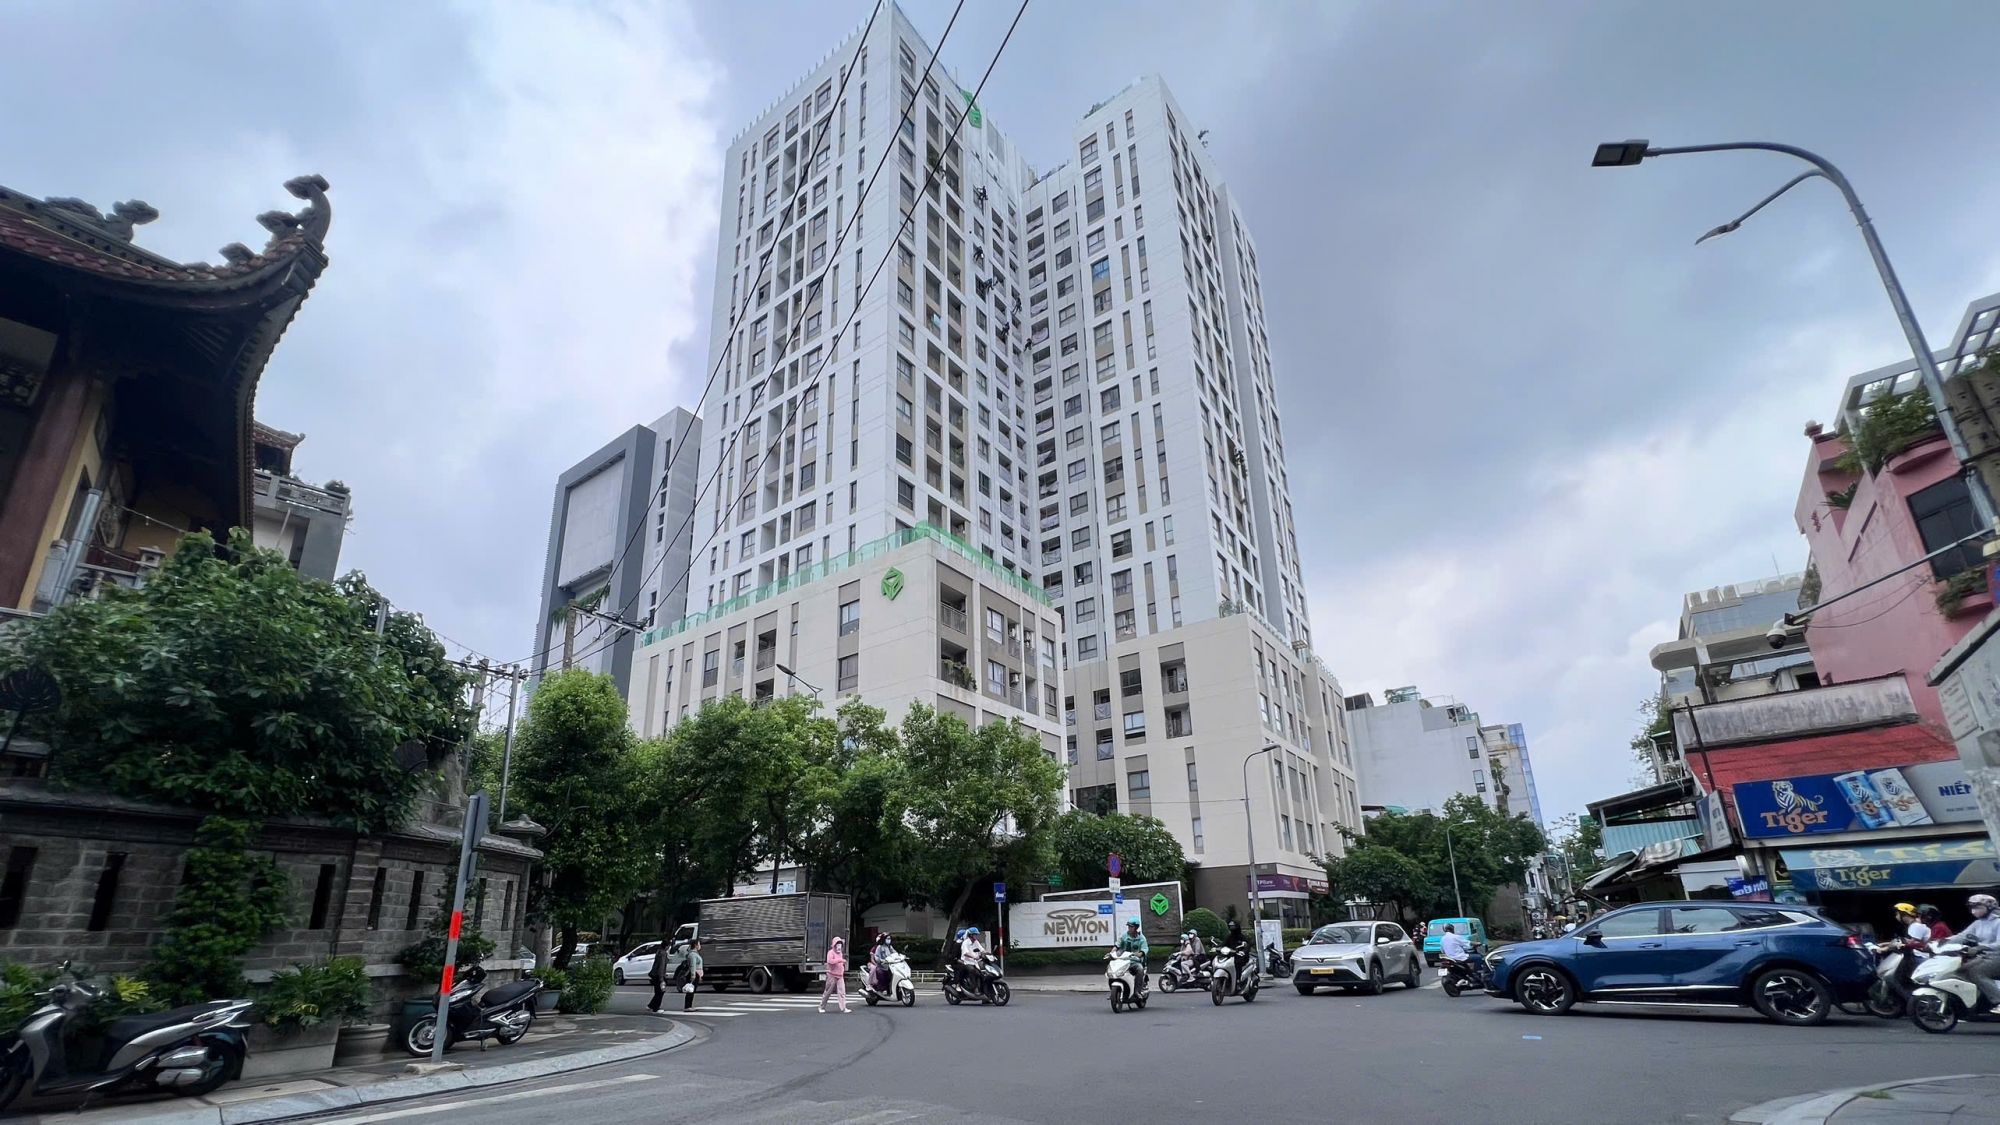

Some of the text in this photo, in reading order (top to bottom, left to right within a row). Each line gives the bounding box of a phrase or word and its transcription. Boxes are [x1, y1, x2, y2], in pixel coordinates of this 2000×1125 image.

[1760, 807, 1828, 833] Tiger
[1835, 865, 1891, 886] Tiger
[1044, 919, 1109, 935] NEWTON
